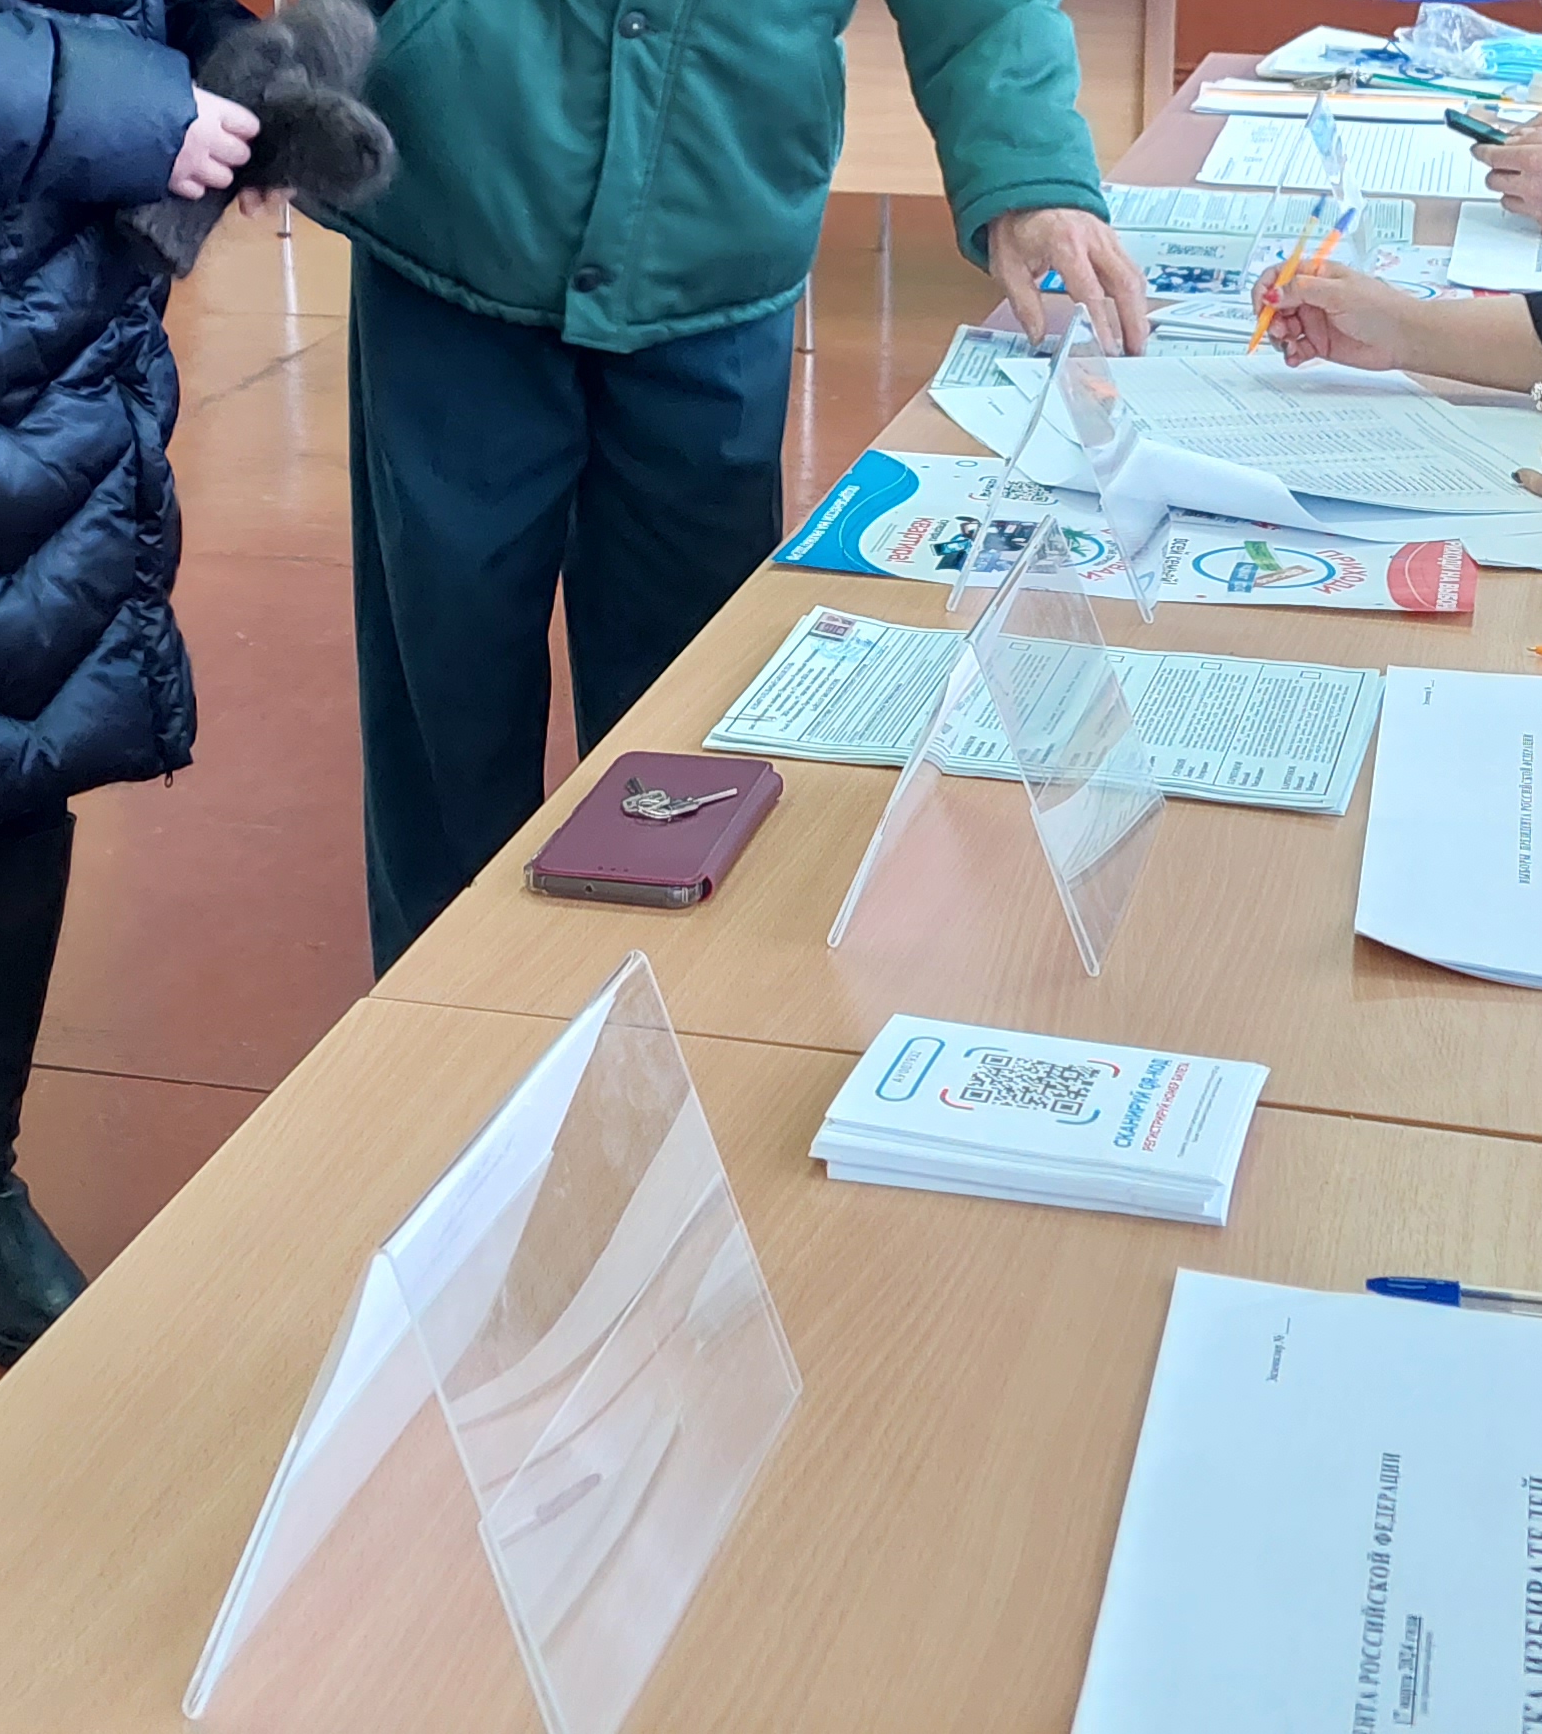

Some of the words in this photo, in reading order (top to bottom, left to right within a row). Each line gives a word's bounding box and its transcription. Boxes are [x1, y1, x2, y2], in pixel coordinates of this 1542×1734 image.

[885, 517, 935, 564] квартира!
[1312, 549, 1368, 595] ПРИХОДИ
[1113, 1090, 1152, 1148] СКАНИРУЙ
[1138, 1058, 1172, 1090] QR-КОД
[1142, 1102, 1170, 1152] РЕГИСТРИРУЙ
[1162, 1081, 1180, 1104] НОМЕР
[1374, 1452, 1401, 1547] ФЕДЕРАЦИИ
[1359, 1551, 1391, 1687] РОССИЙСКОЙ
